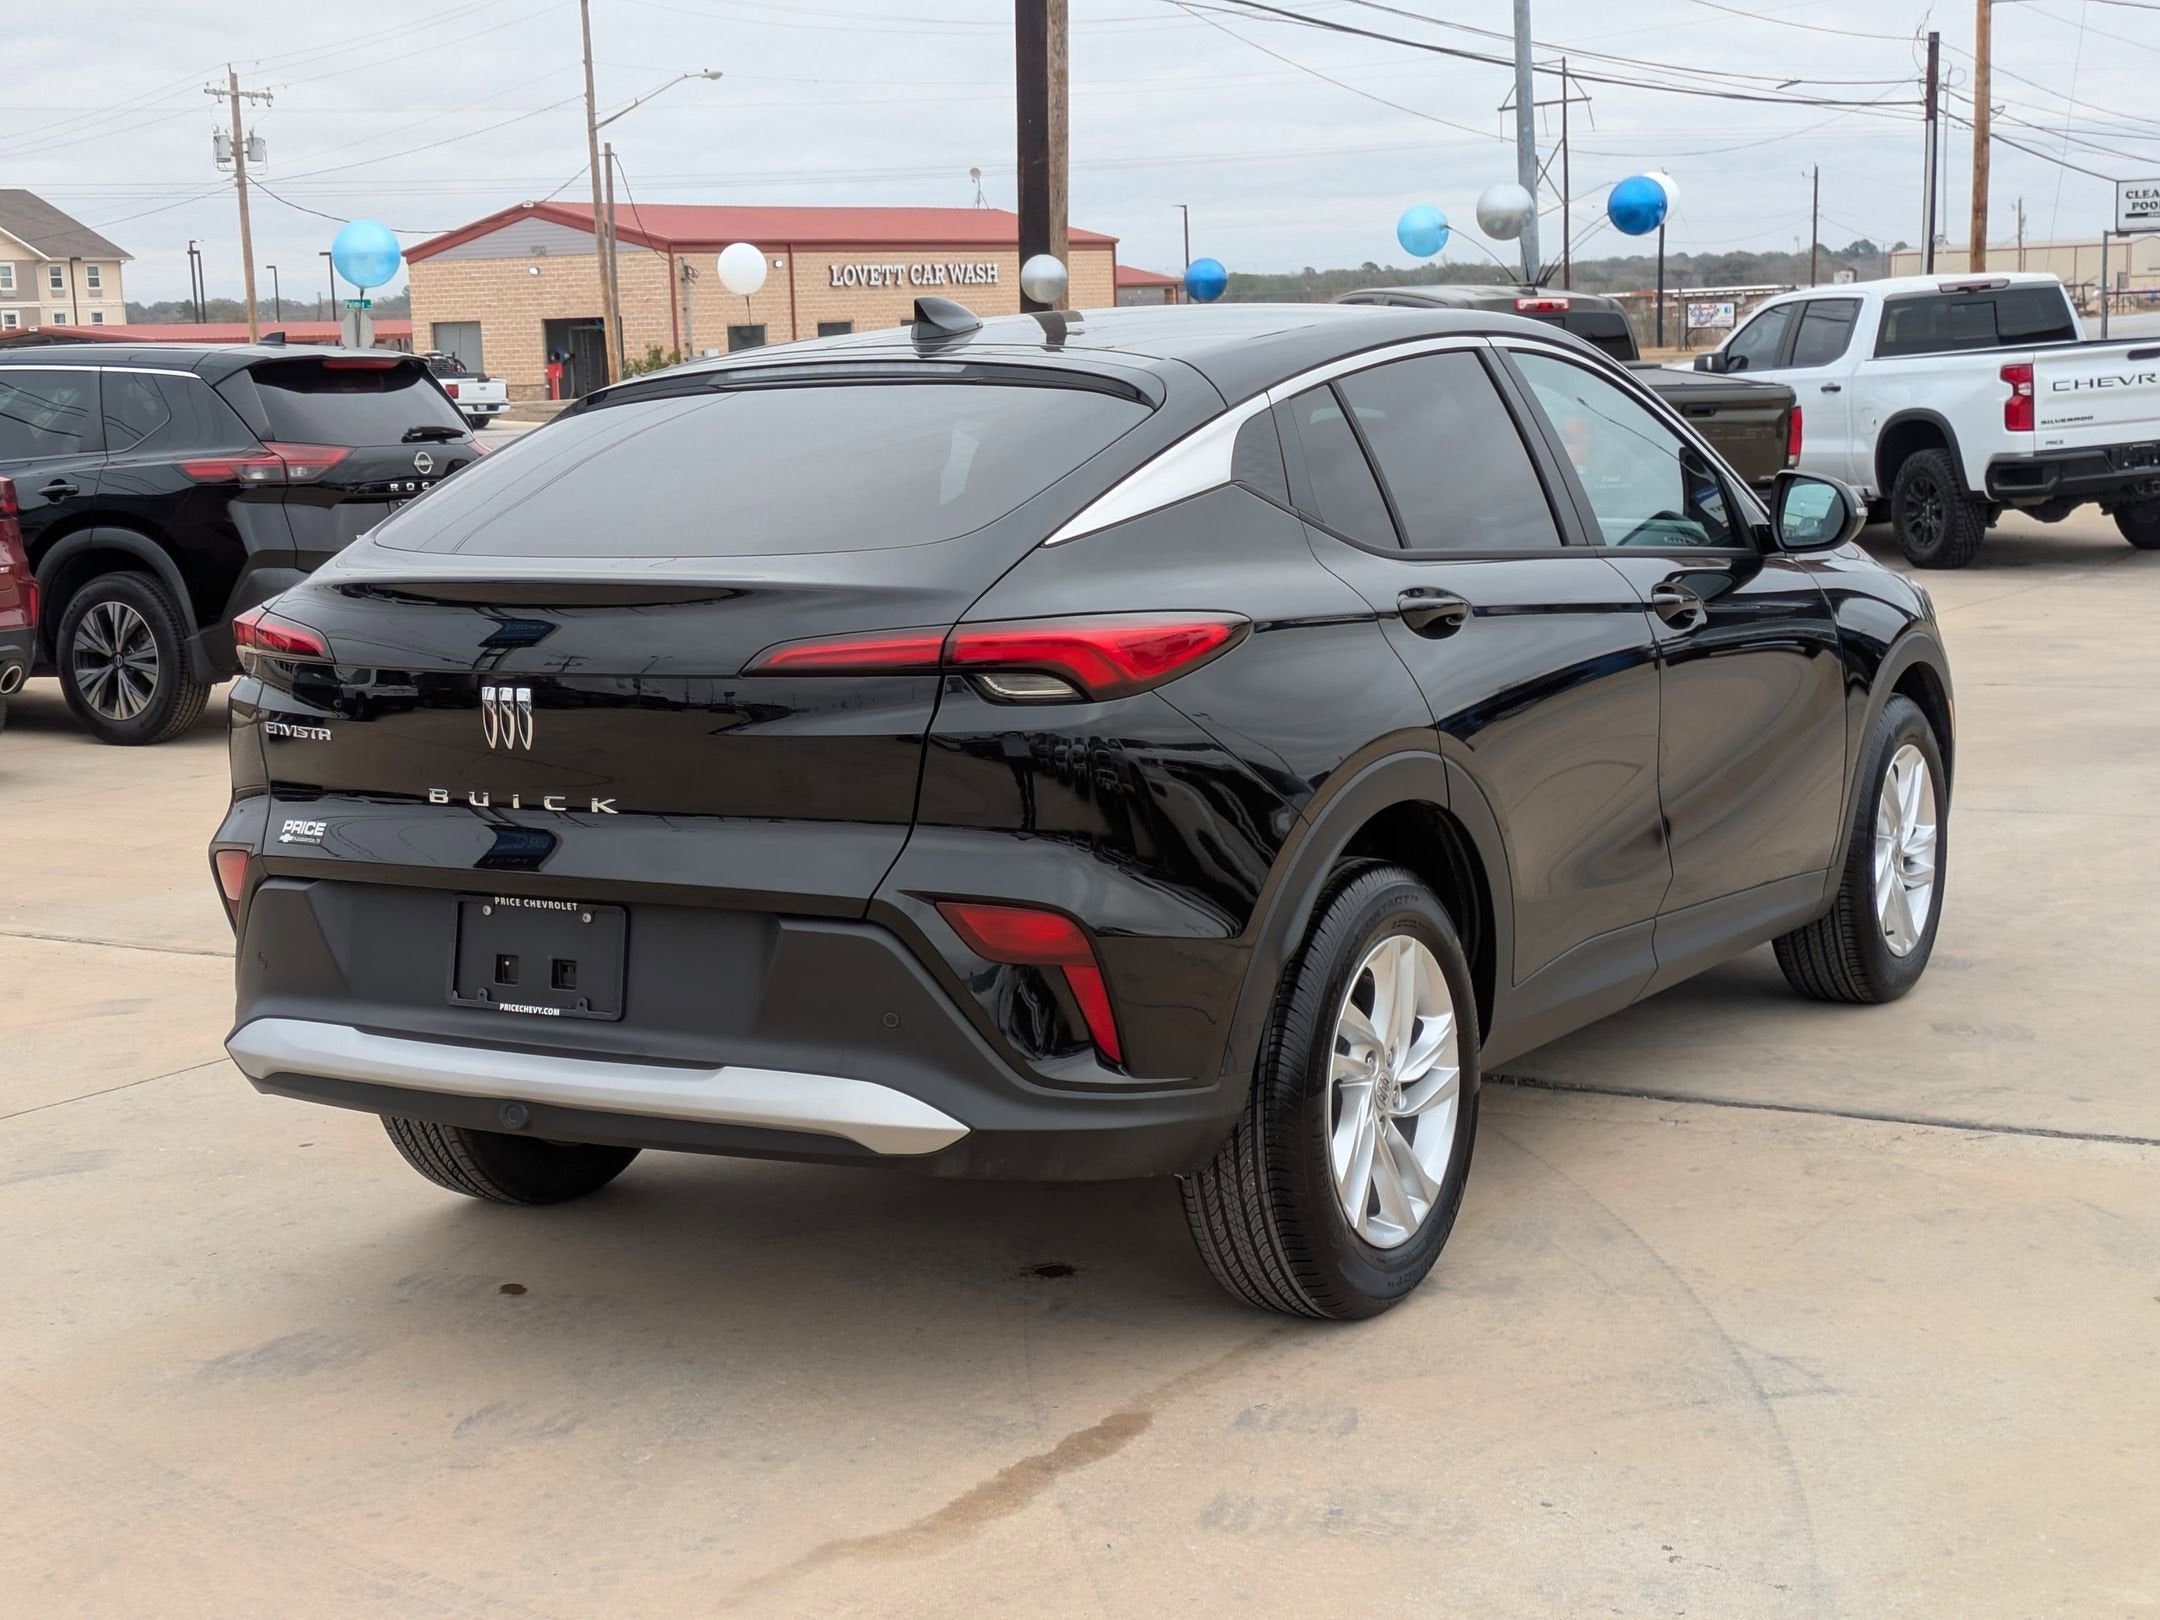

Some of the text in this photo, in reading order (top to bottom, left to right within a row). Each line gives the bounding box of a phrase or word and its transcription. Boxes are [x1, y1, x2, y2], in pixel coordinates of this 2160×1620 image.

[2131, 201, 2160, 210] POO
[829, 263, 999, 288] LOVETT CAR WASH
[2040, 415, 2094, 425] SILVERADO
[389, 481, 440, 492] ROG
[264, 721, 332, 741] ENVISTA
[428, 787, 619, 814] BUICK
[281, 820, 327, 837] PRICE
[494, 896, 578, 911] PRICE CHEVROLET
[499, 1003, 561, 1016] PRICECHEVY.COM
